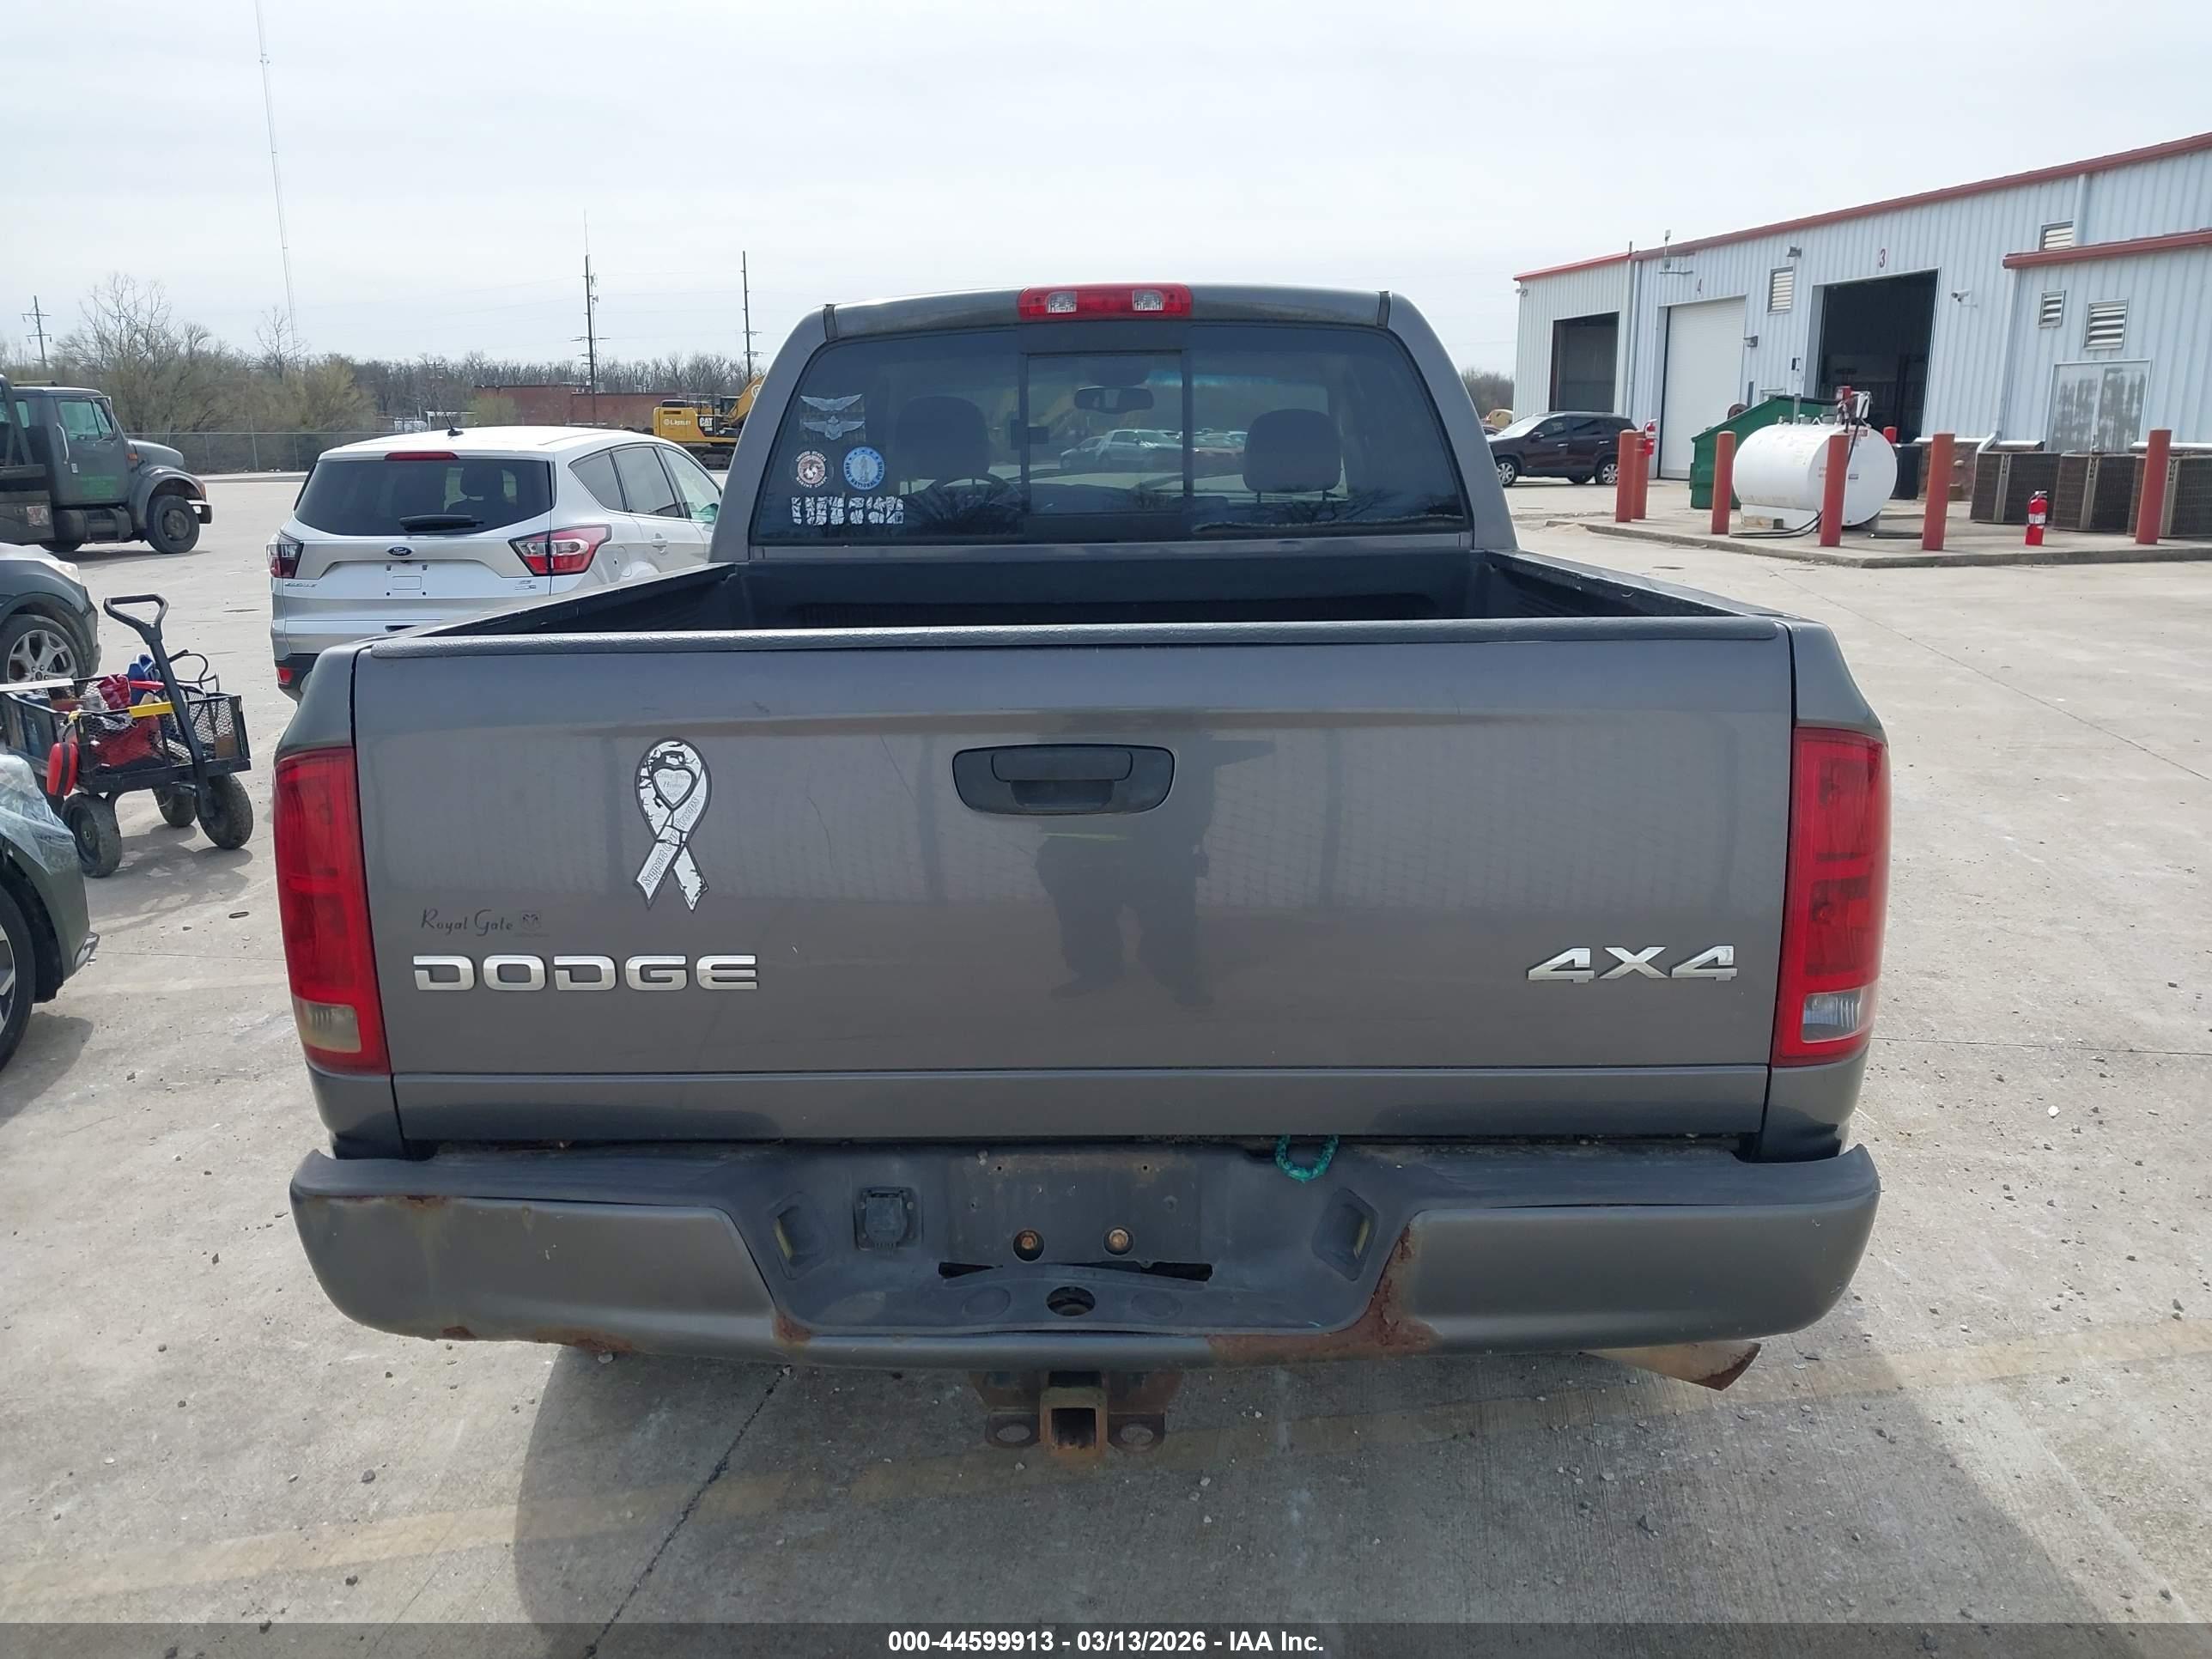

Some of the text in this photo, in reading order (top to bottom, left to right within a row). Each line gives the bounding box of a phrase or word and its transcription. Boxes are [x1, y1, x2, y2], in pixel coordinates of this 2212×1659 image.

[1879, 248, 1887, 269] 3
[1697, 277, 1703, 295] 4
[699, 417, 713, 427] CAT
[795, 451, 827, 462] UNITED STATES
[795, 476, 812, 489] MARINE
[844, 462, 853, 478] ARMY
[850, 477, 877, 488] NATIONAL
[641, 849, 666, 888] Support
[421, 908, 468, 936] Royal
[413, 954, 758, 991] DODGE
